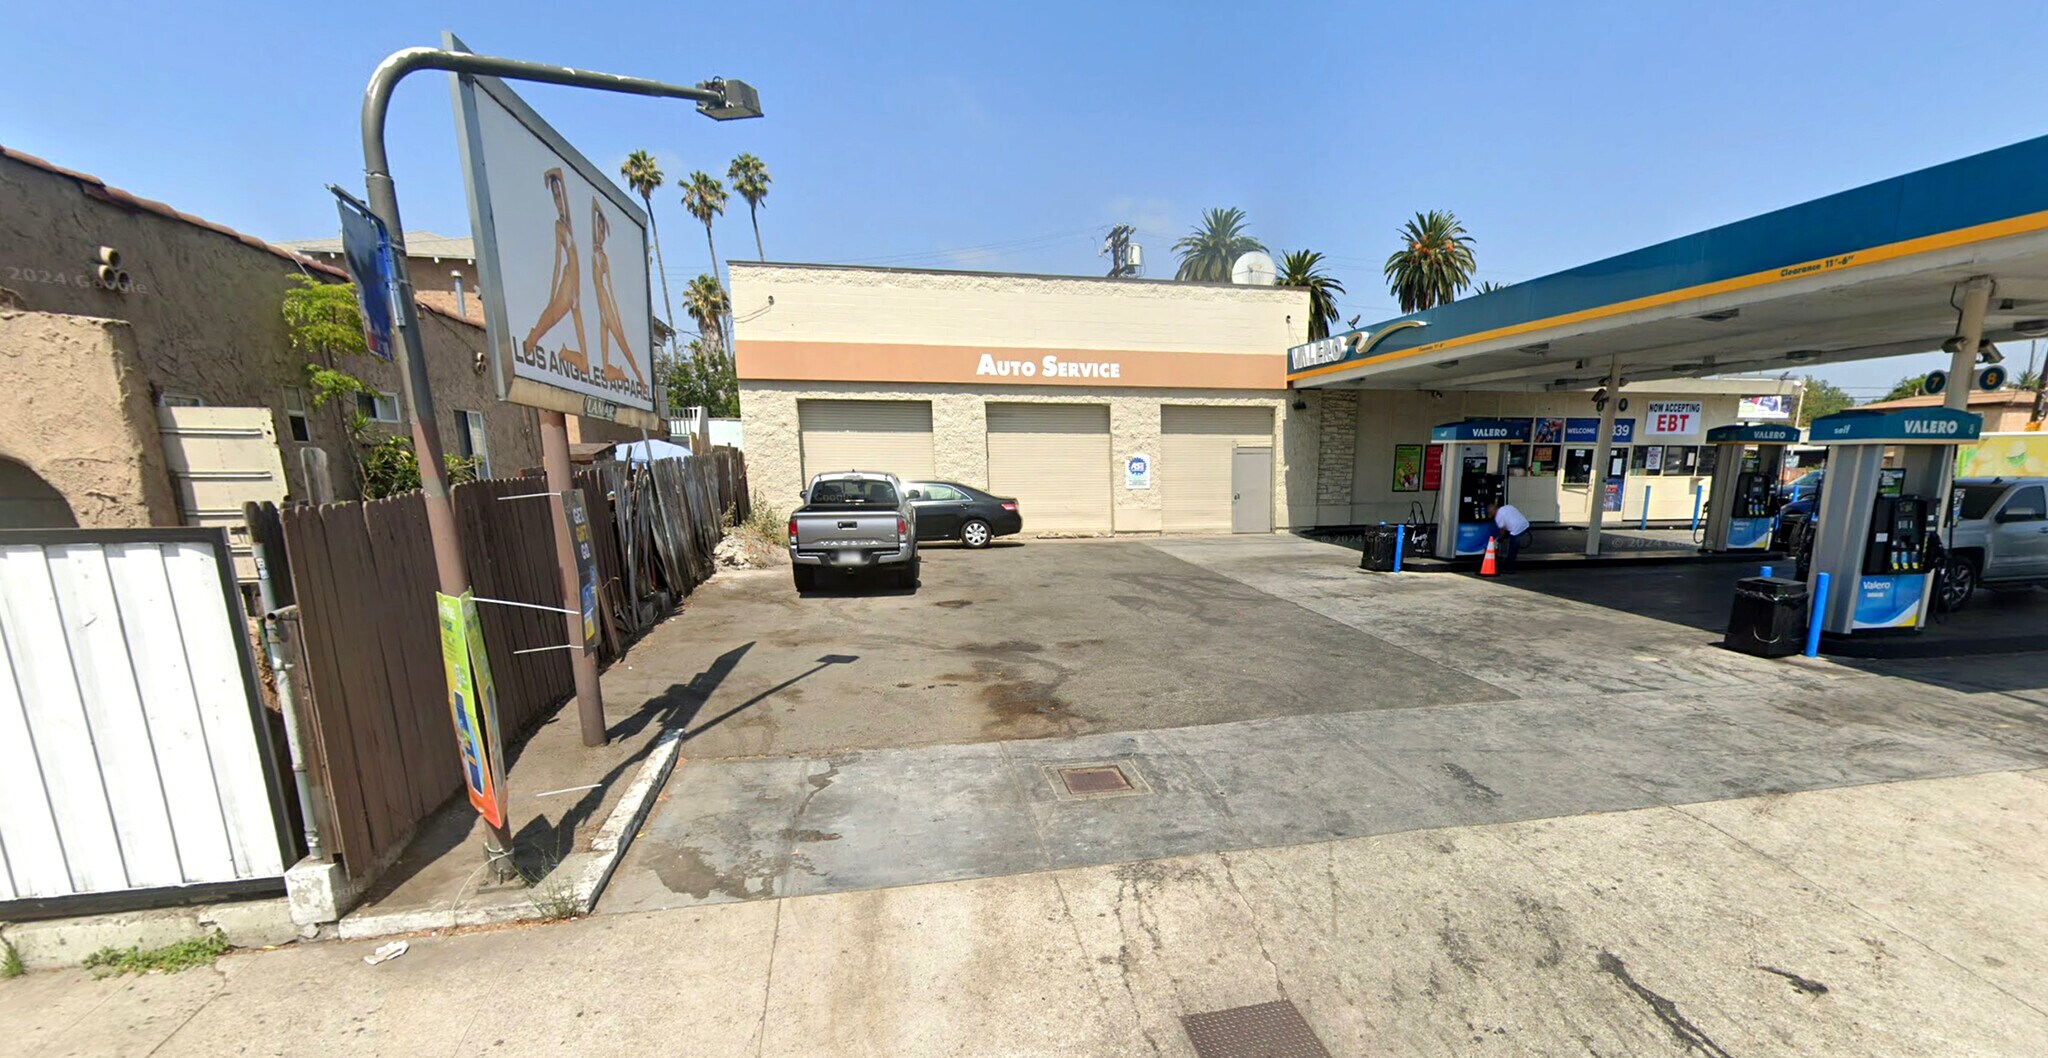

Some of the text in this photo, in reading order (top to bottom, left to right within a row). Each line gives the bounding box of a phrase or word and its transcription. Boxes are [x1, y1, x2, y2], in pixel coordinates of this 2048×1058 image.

[1781, 264, 1821, 277] Clearance
[512, 336, 547, 370] LOS
[1292, 336, 1347, 369] VALERO
[1931, 376, 1940, 389] 7
[1986, 372, 1997, 385] 8
[587, 397, 615, 417] LAMAR
[1649, 403, 1700, 412] NOW ACCEPTING
[1656, 414, 1689, 432] EBT
[1834, 424, 1851, 434] self
[1904, 420, 1958, 434] VALERO
[1472, 428, 1507, 437] VALERO
[1754, 431, 1786, 439] VALERO
[1863, 581, 1891, 589] Valero
